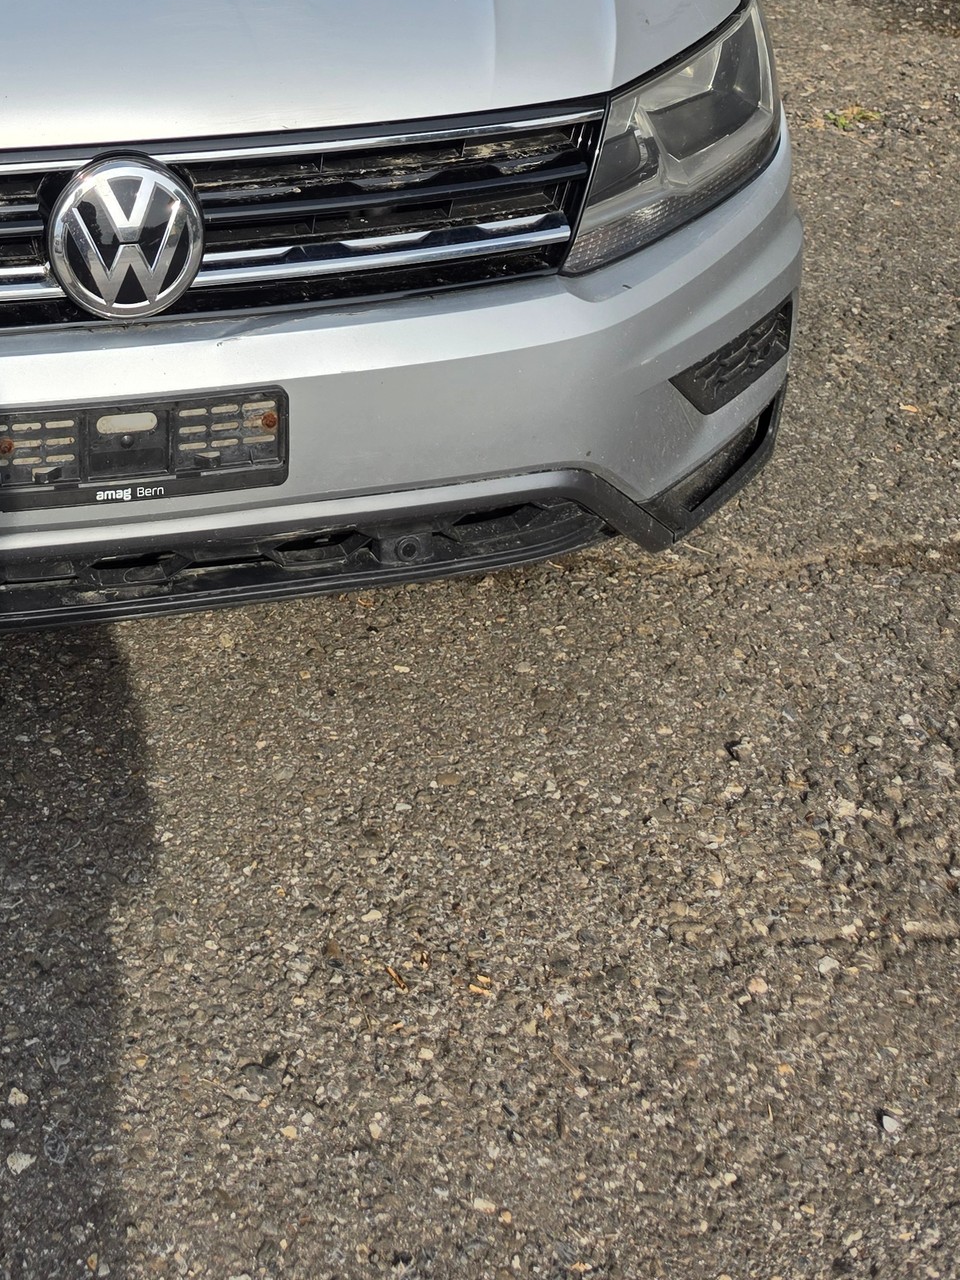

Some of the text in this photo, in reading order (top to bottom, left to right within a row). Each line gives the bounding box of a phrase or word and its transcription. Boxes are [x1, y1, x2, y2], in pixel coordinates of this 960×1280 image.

[58, 166, 195, 310] VW
[96, 486, 165, 501] amag Bern
